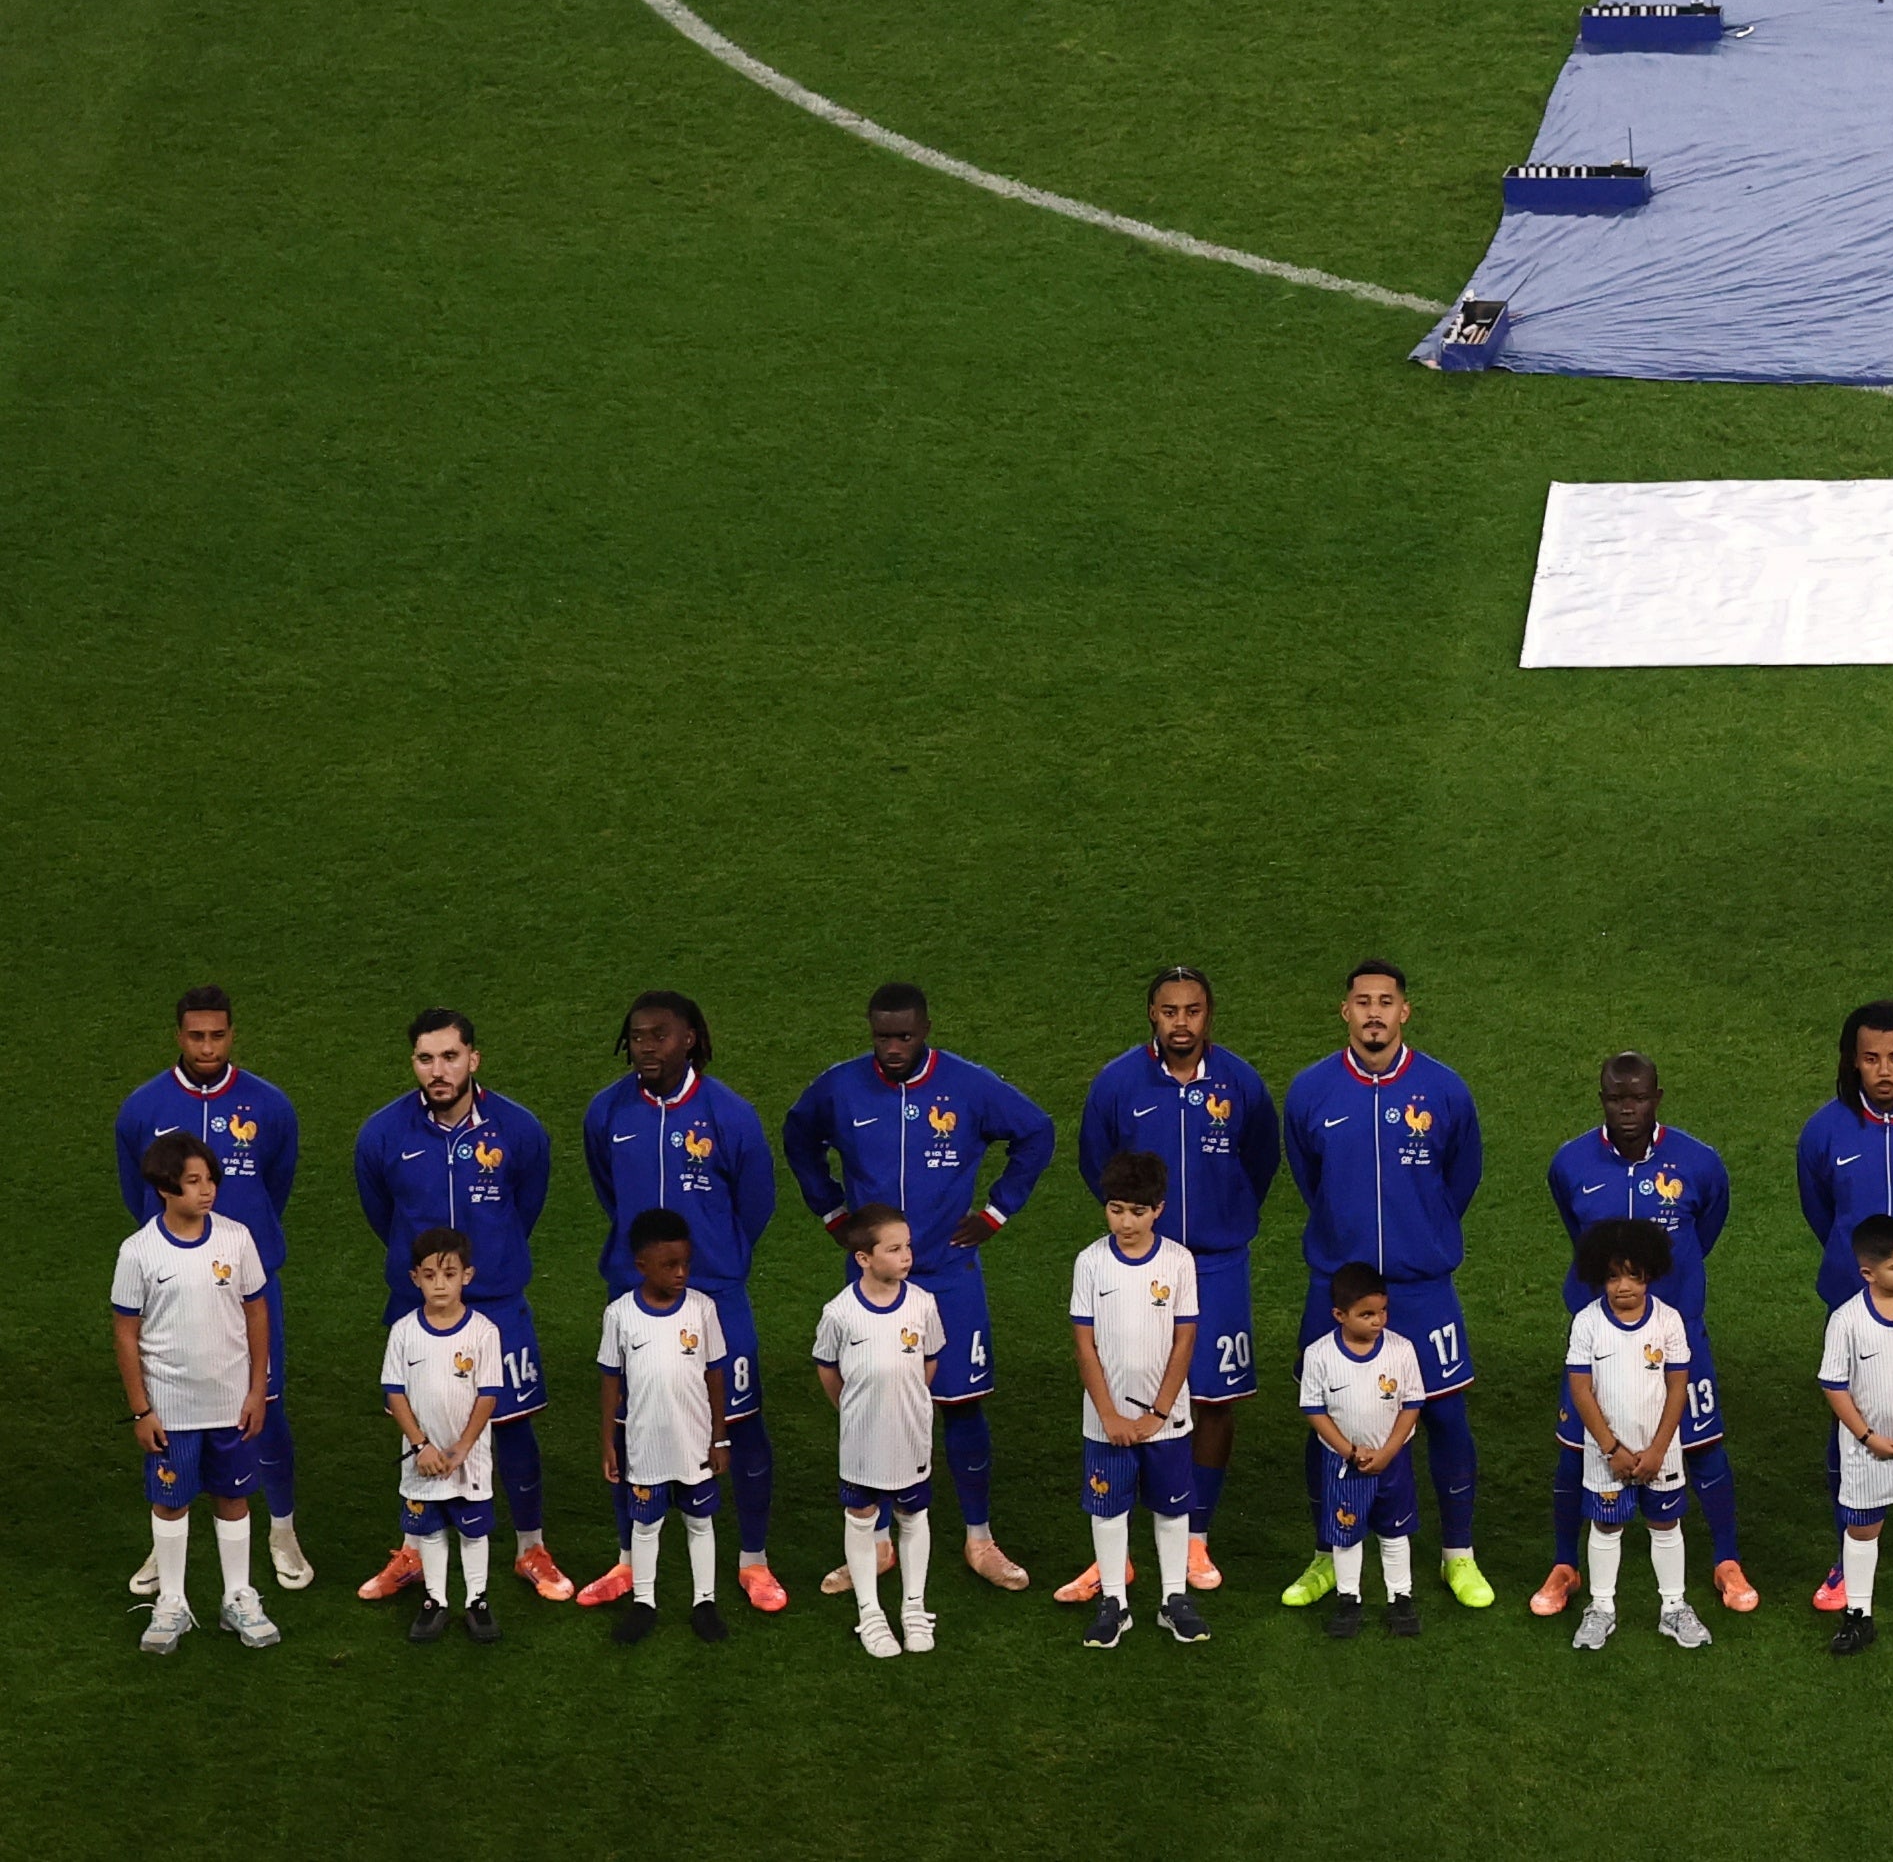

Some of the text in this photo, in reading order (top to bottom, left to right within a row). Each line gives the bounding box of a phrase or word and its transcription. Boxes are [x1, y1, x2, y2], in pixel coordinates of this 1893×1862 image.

[971, 1330, 986, 1367] 4
[1217, 1331, 1249, 1373] 20
[1429, 1322, 1459, 1365] 17
[504, 1346, 538, 1389] 14
[734, 1356, 749, 1392] 8
[1687, 1378, 1714, 1418] 13
